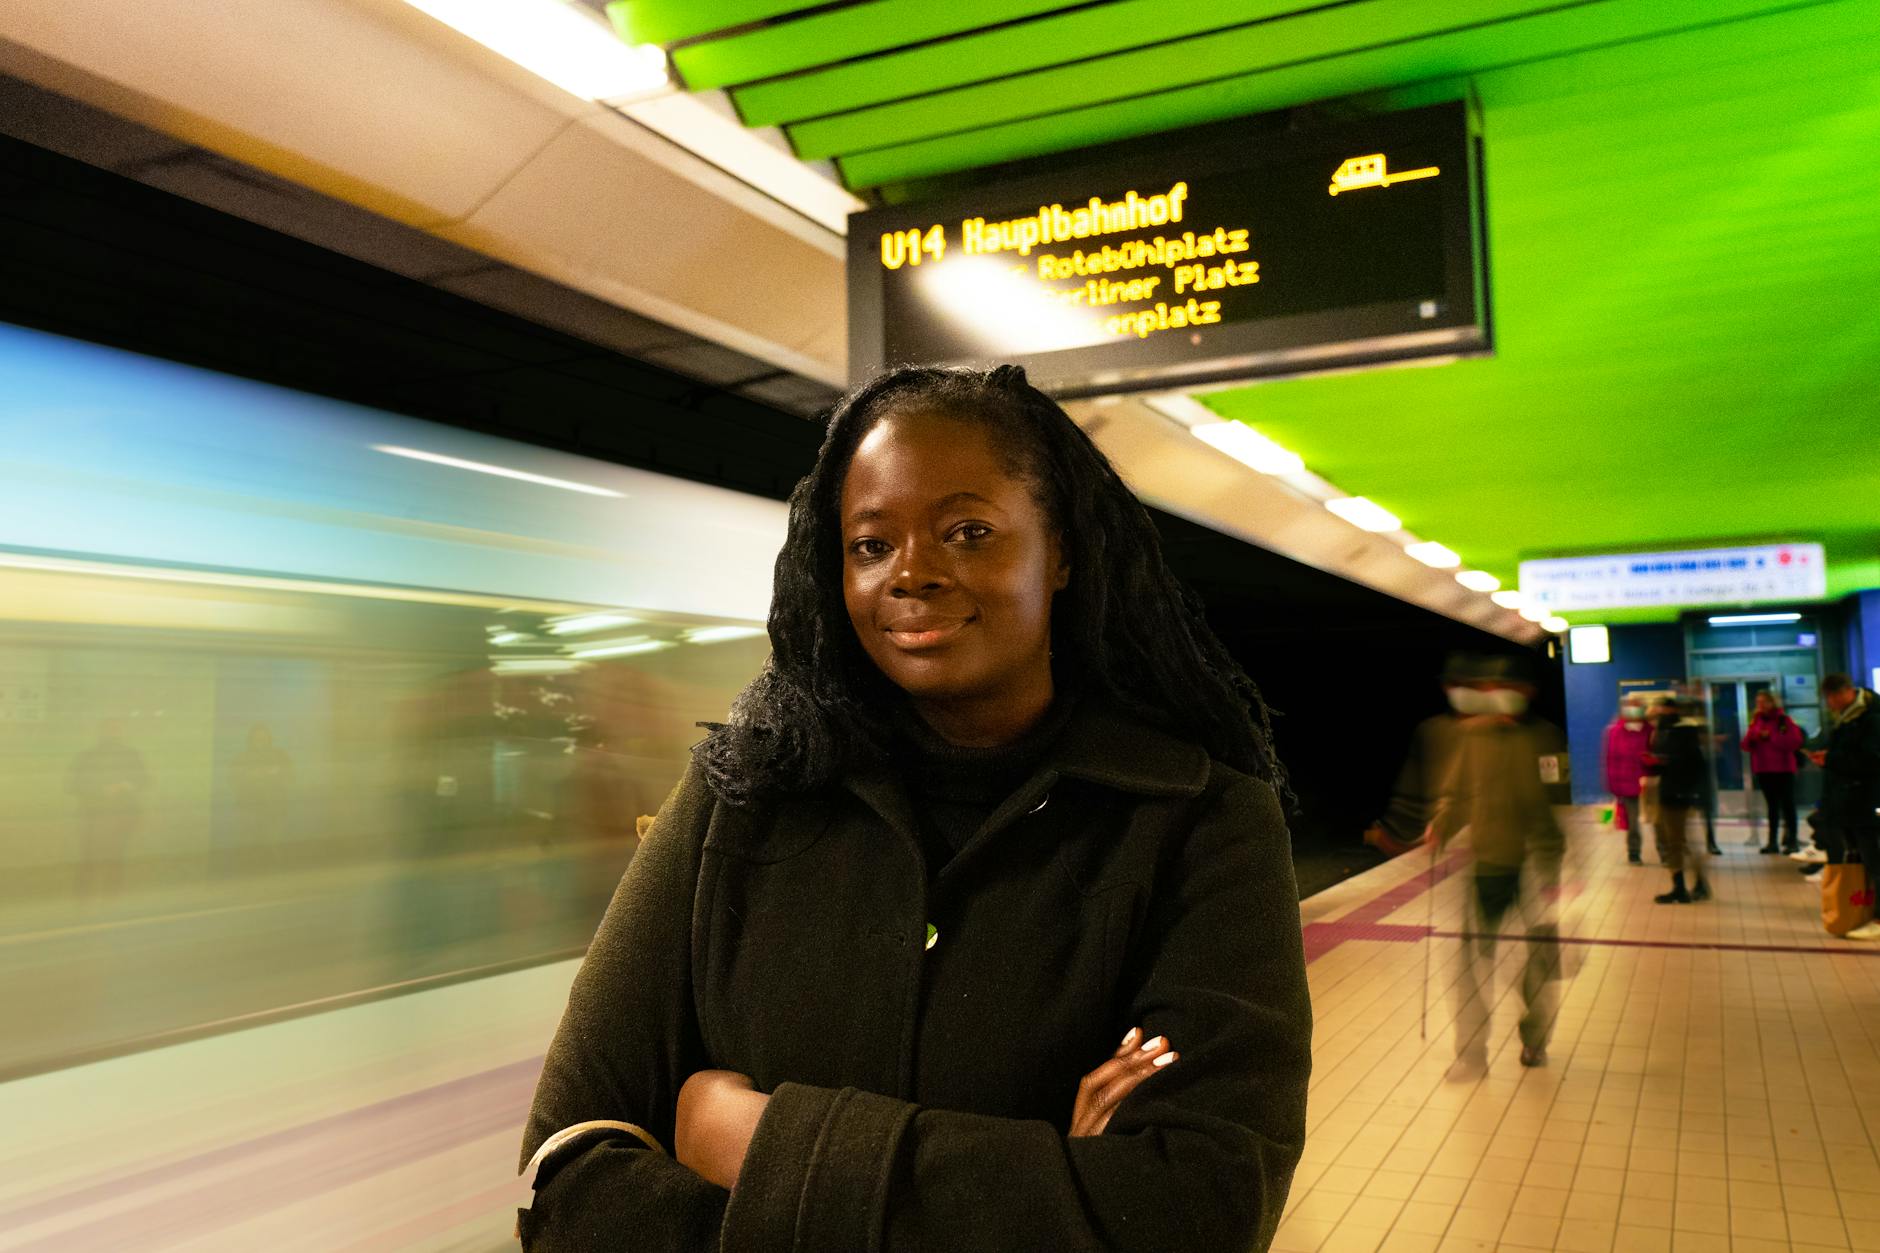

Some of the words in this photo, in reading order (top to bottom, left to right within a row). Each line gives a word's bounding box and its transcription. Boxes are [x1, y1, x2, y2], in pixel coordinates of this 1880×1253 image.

[881, 223, 946, 270] U14
[1175, 259, 1259, 294] Platz
[1099, 298, 1221, 338] enplatz
